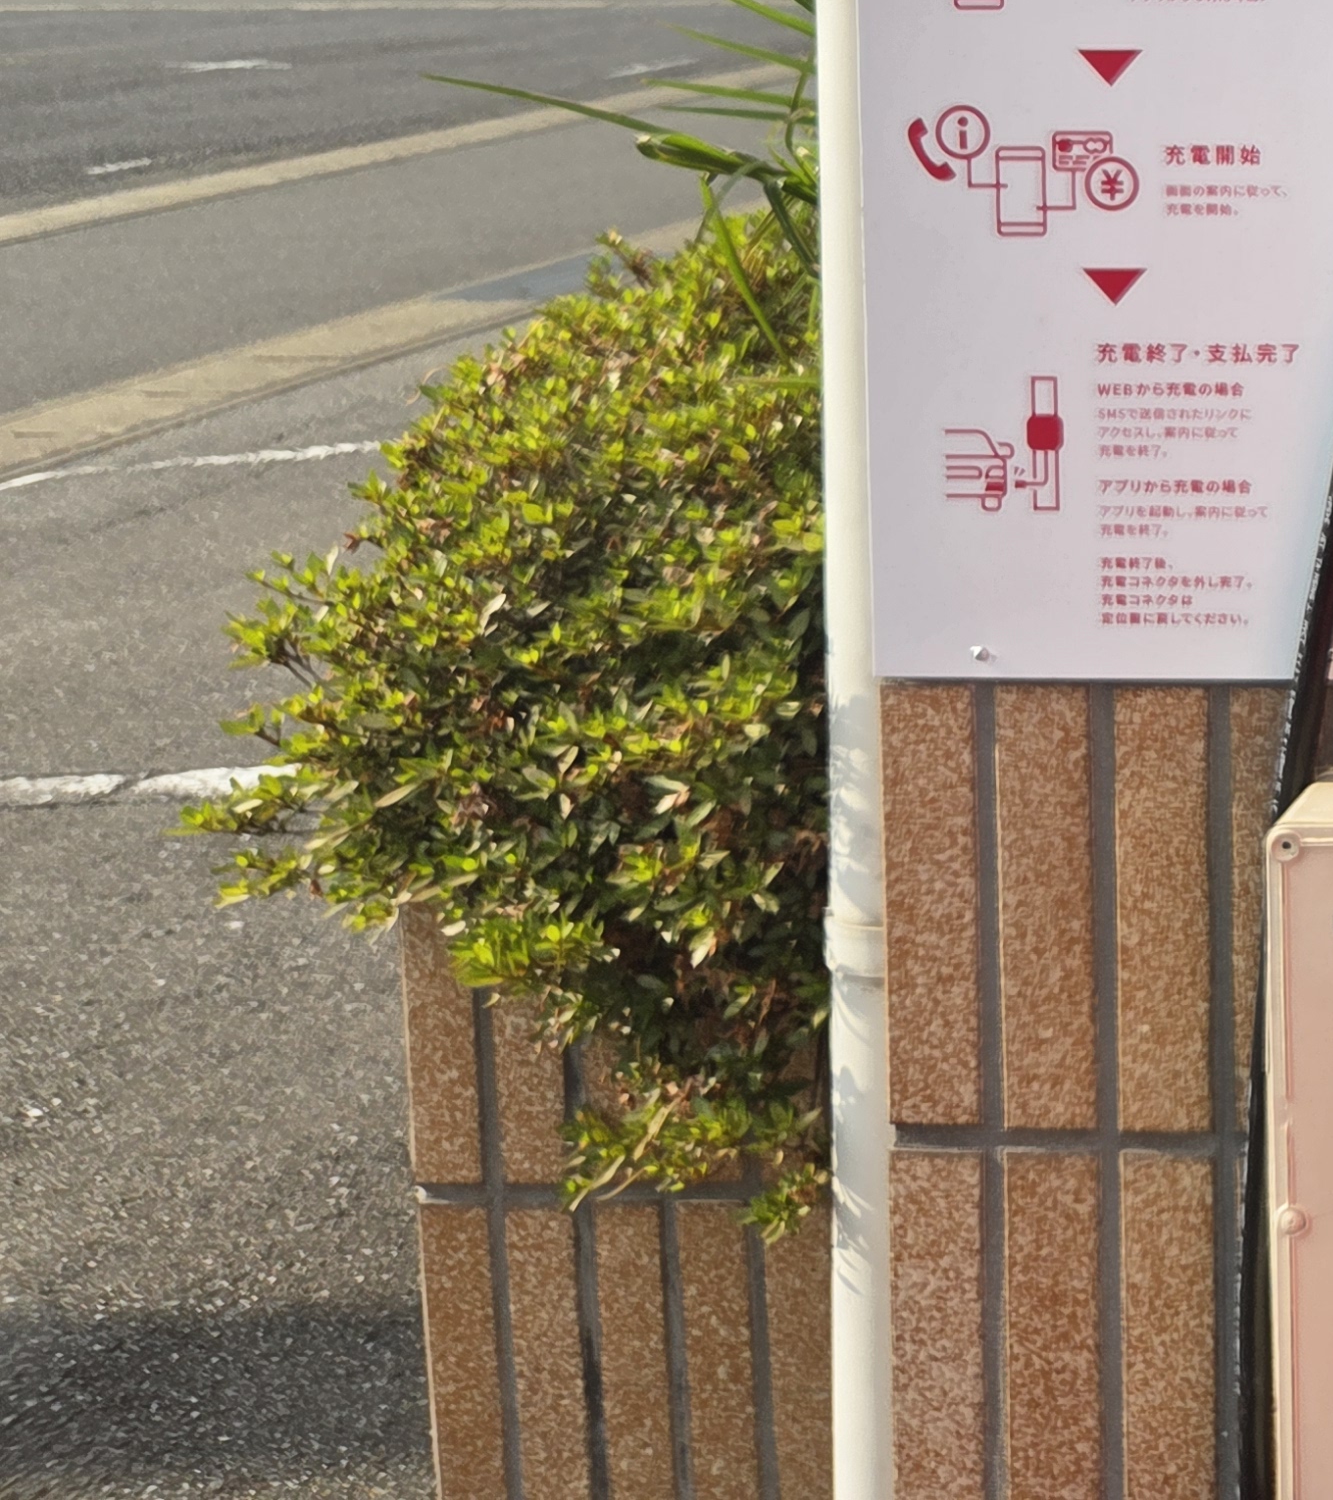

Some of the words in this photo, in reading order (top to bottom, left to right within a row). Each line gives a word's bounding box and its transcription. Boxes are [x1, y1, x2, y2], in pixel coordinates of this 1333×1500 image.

[1165, 145, 1262, 166] 充電開始
[1166, 203, 1240, 216] 充電を開始。
[1097, 343, 1300, 364] 充電終了・支払完了
[1097, 382, 1244, 397] WEBから充電の場合
[1099, 444, 1169, 458] 充電を終了。
[1100, 479, 1251, 494] アプリから充電の場合
[1100, 523, 1170, 537] 充電を終了。
[1101, 593, 1193, 607] 充電コネクタは
